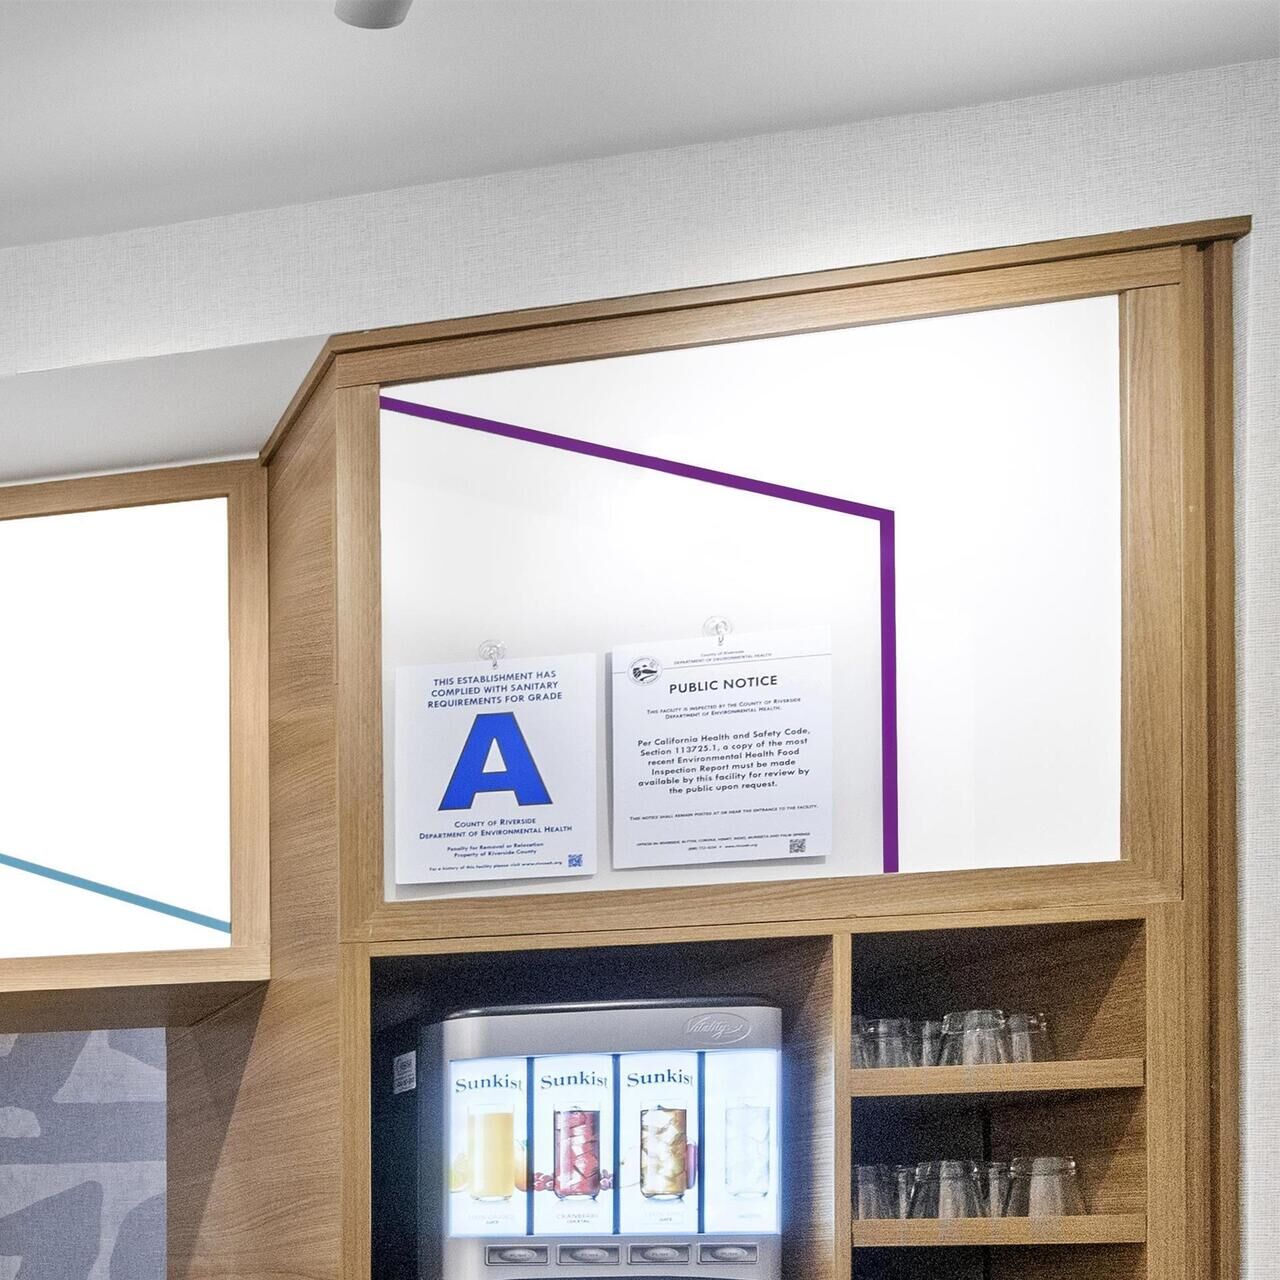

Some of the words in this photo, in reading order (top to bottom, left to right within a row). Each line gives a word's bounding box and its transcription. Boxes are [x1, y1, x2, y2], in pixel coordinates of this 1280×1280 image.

[434, 678, 454, 687] THIS
[457, 672, 533, 685] ESTABLISHMENT
[536, 671, 556, 679] HAS
[670, 680, 719, 694] PUBLIC
[724, 675, 778, 690] NOTICE
[431, 688, 481, 697] COMPLIED
[484, 685, 508, 694] WITH
[511, 681, 558, 692] SANITARY
[428, 696, 502, 709] REQUIREMENTS
[505, 695, 524, 703] FOR
[528, 692, 563, 702] GRADE
[638, 739, 652, 747] Per
[654, 736, 698, 746] California
[701, 734, 730, 742] Health
[733, 732, 750, 740] and
[753, 730, 782, 739] Safety
[640, 748, 672, 757] Section
[732, 743, 753, 751] copy
[768, 739, 783, 747] the
[785, 738, 808, 746] most
[438, 711, 553, 811] A
[648, 758, 675, 766] recent
[677, 753, 742, 764] Environmental
[745, 751, 775, 759] Health
[778, 748, 800, 756] Food
[652, 767, 697, 777] Inspection
[700, 764, 729, 773] Report
[771, 759, 796, 767] made
[638, 777, 680, 787] available
[683, 776, 693, 785] by
[696, 775, 713, 783] this
[716, 772, 746, 781] facility
[749, 771, 762, 779] for
[764, 769, 795, 778] review
[798, 768, 810, 776] by
[669, 787, 683, 795] the
[686, 785, 713, 794] public
[716, 784, 739, 792] upon
[742, 781, 778, 790] request.
[454, 821, 485, 829] COUNTY
[500, 818, 536, 826] RIVERSIDE
[419, 831, 466, 840] DEPARTMENT
[480, 828, 542, 837] ENVIRONMENTAL
[544, 825, 573, 833] HEALTH
